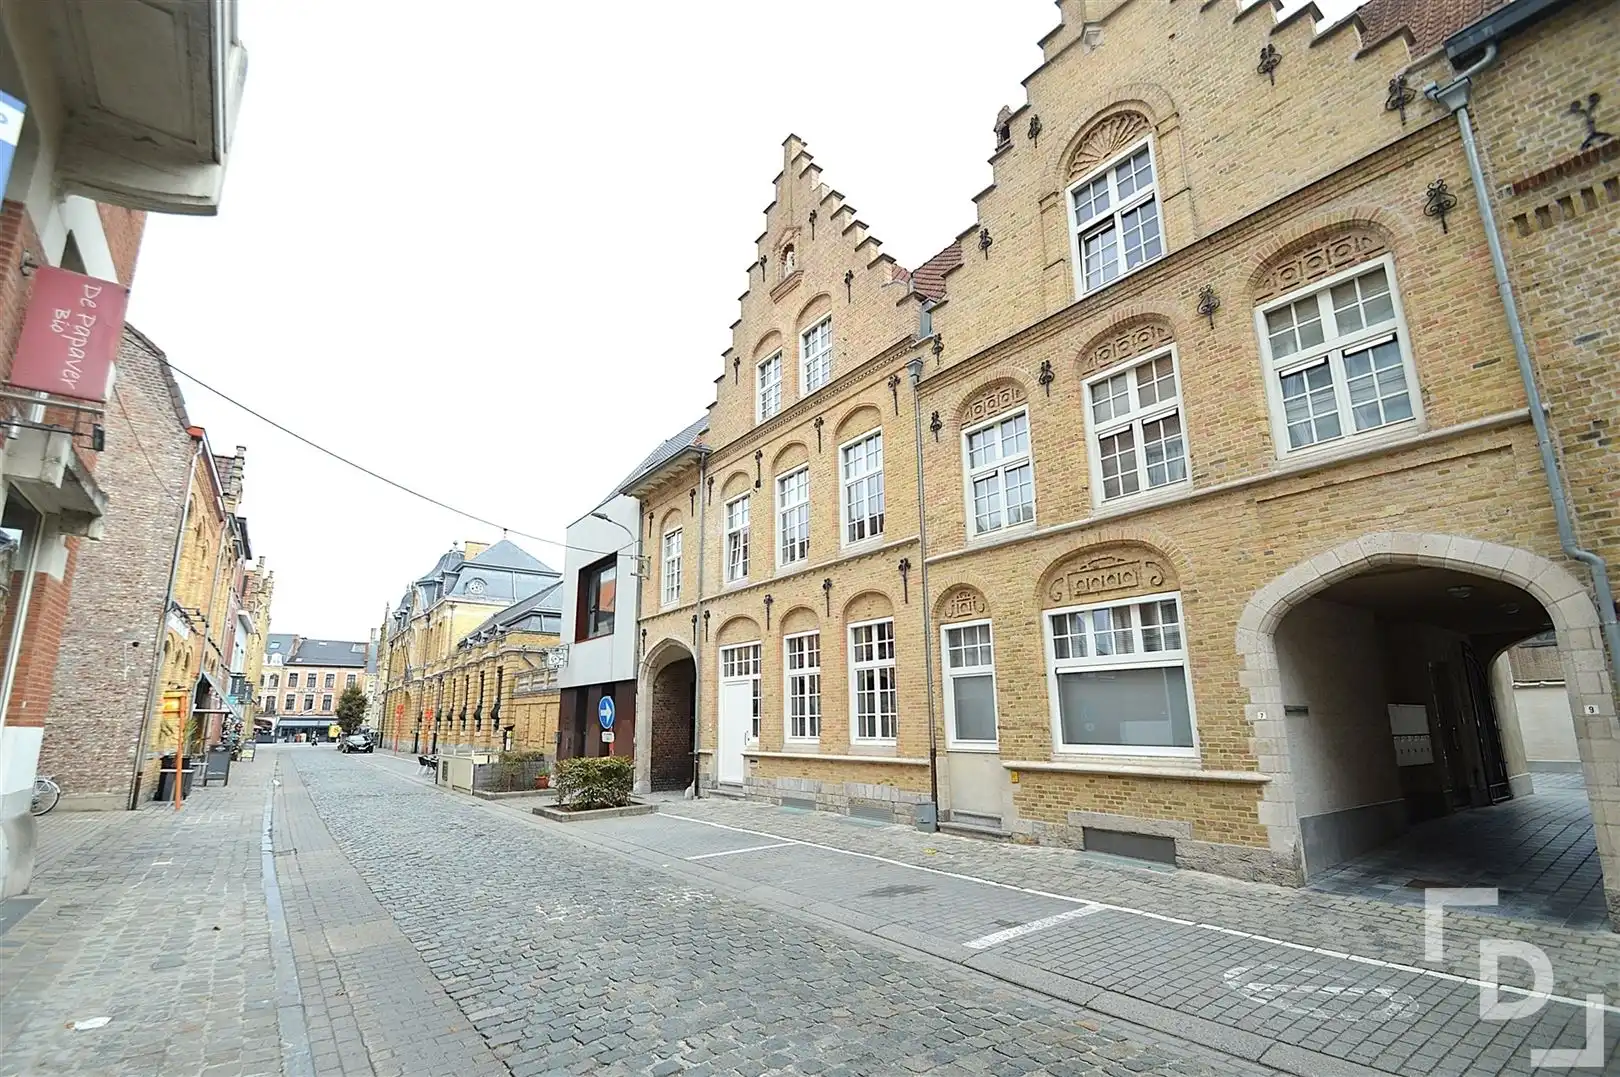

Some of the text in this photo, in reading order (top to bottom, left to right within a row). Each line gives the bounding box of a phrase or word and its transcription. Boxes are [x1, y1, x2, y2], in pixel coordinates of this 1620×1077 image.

[50, 308, 72, 333] Bio
[60, 284, 102, 390] De Papaver
[1588, 705, 1595, 714] 9
